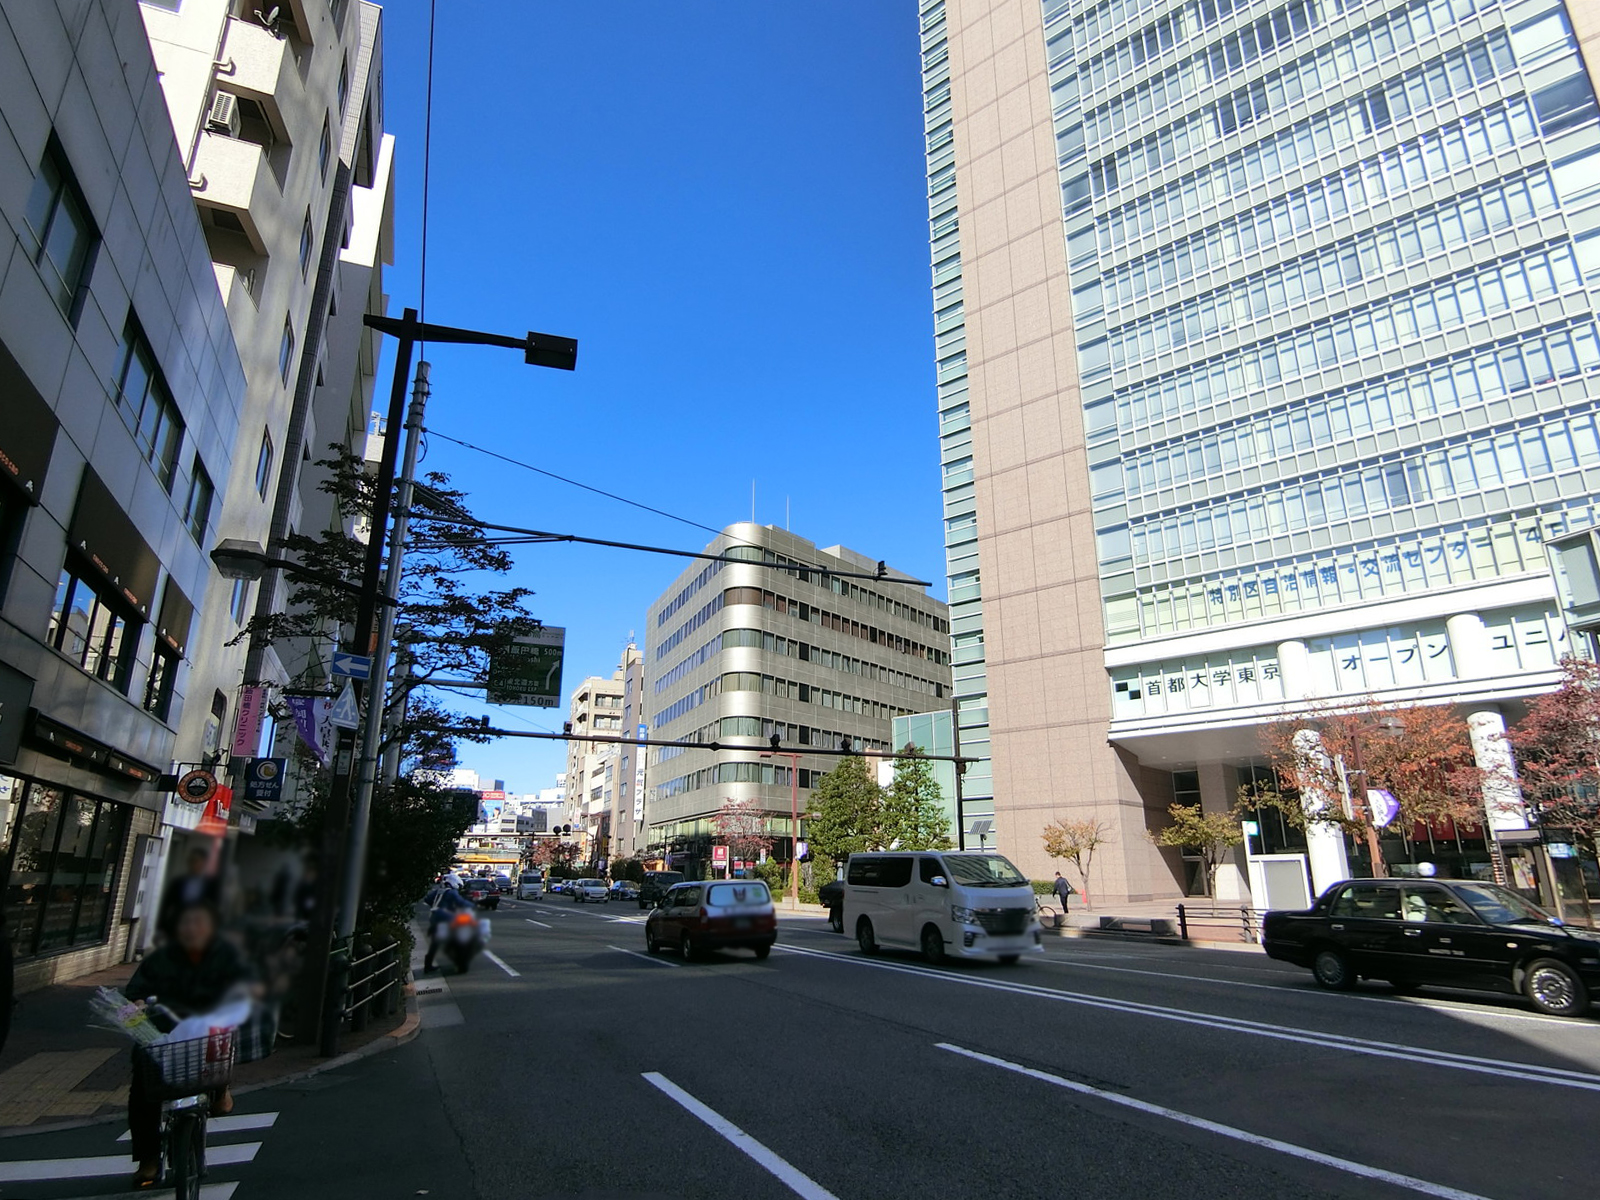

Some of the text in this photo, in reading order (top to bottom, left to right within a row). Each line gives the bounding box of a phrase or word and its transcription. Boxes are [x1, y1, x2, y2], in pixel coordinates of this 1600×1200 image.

[1145, 663, 1282, 696] 首都大学東京
[1341, 642, 1448, 671] オープン
[249, 781, 279, 789] 処方せん
